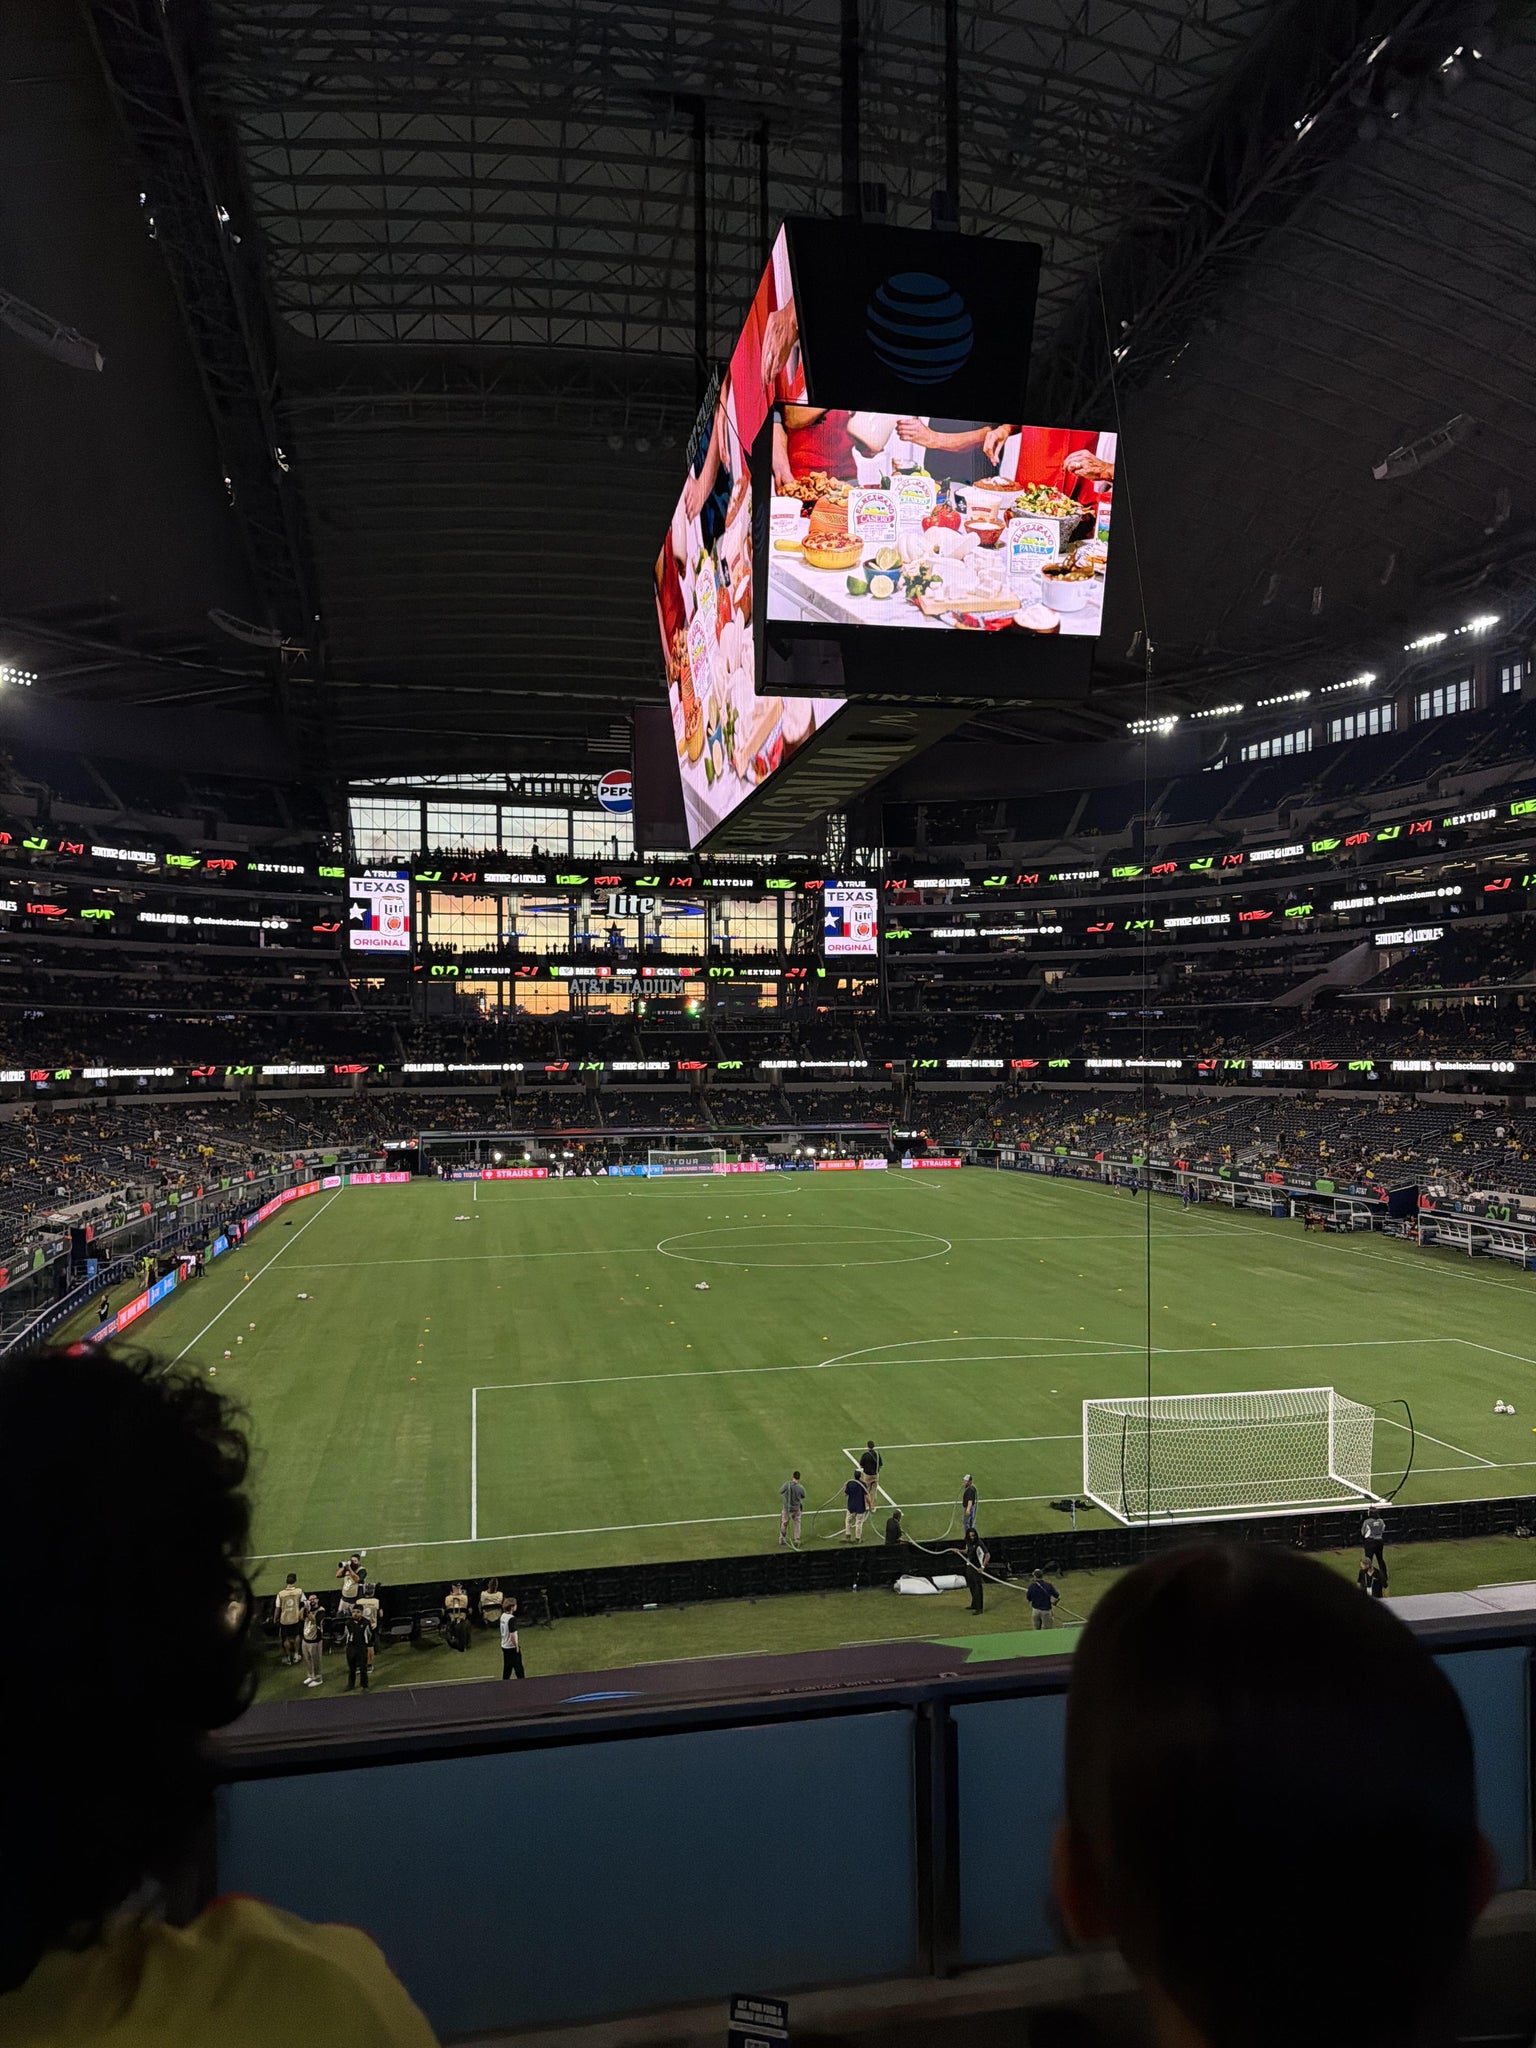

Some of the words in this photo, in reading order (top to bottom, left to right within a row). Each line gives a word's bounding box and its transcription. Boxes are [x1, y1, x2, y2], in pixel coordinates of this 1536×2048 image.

[601, 786, 632, 797] PEPS
[1443, 809, 1497, 828] MEXTOUR
[247, 862, 305, 874] MEXTOUR
[372, 870, 397, 878] TRUE
[1049, 870, 1100, 881] MEXTOUR
[352, 881, 406, 893] TEXAS
[702, 879, 754, 887] MEXTOUR
[827, 891, 874, 902] TEXAS
[606, 894, 655, 919] Lite
[353, 938, 406, 947] ORIGINAL
[575, 967, 596, 976] MEX
[656, 968, 676, 976] COL
[569, 978, 609, 994] AT&T
[613, 978, 685, 994] STADIUM
[921, 1160, 952, 1168] STRAUSS
[496, 1169, 534, 1178] STRAUSS
[1462, 1204, 1476, 1213] AT&T
